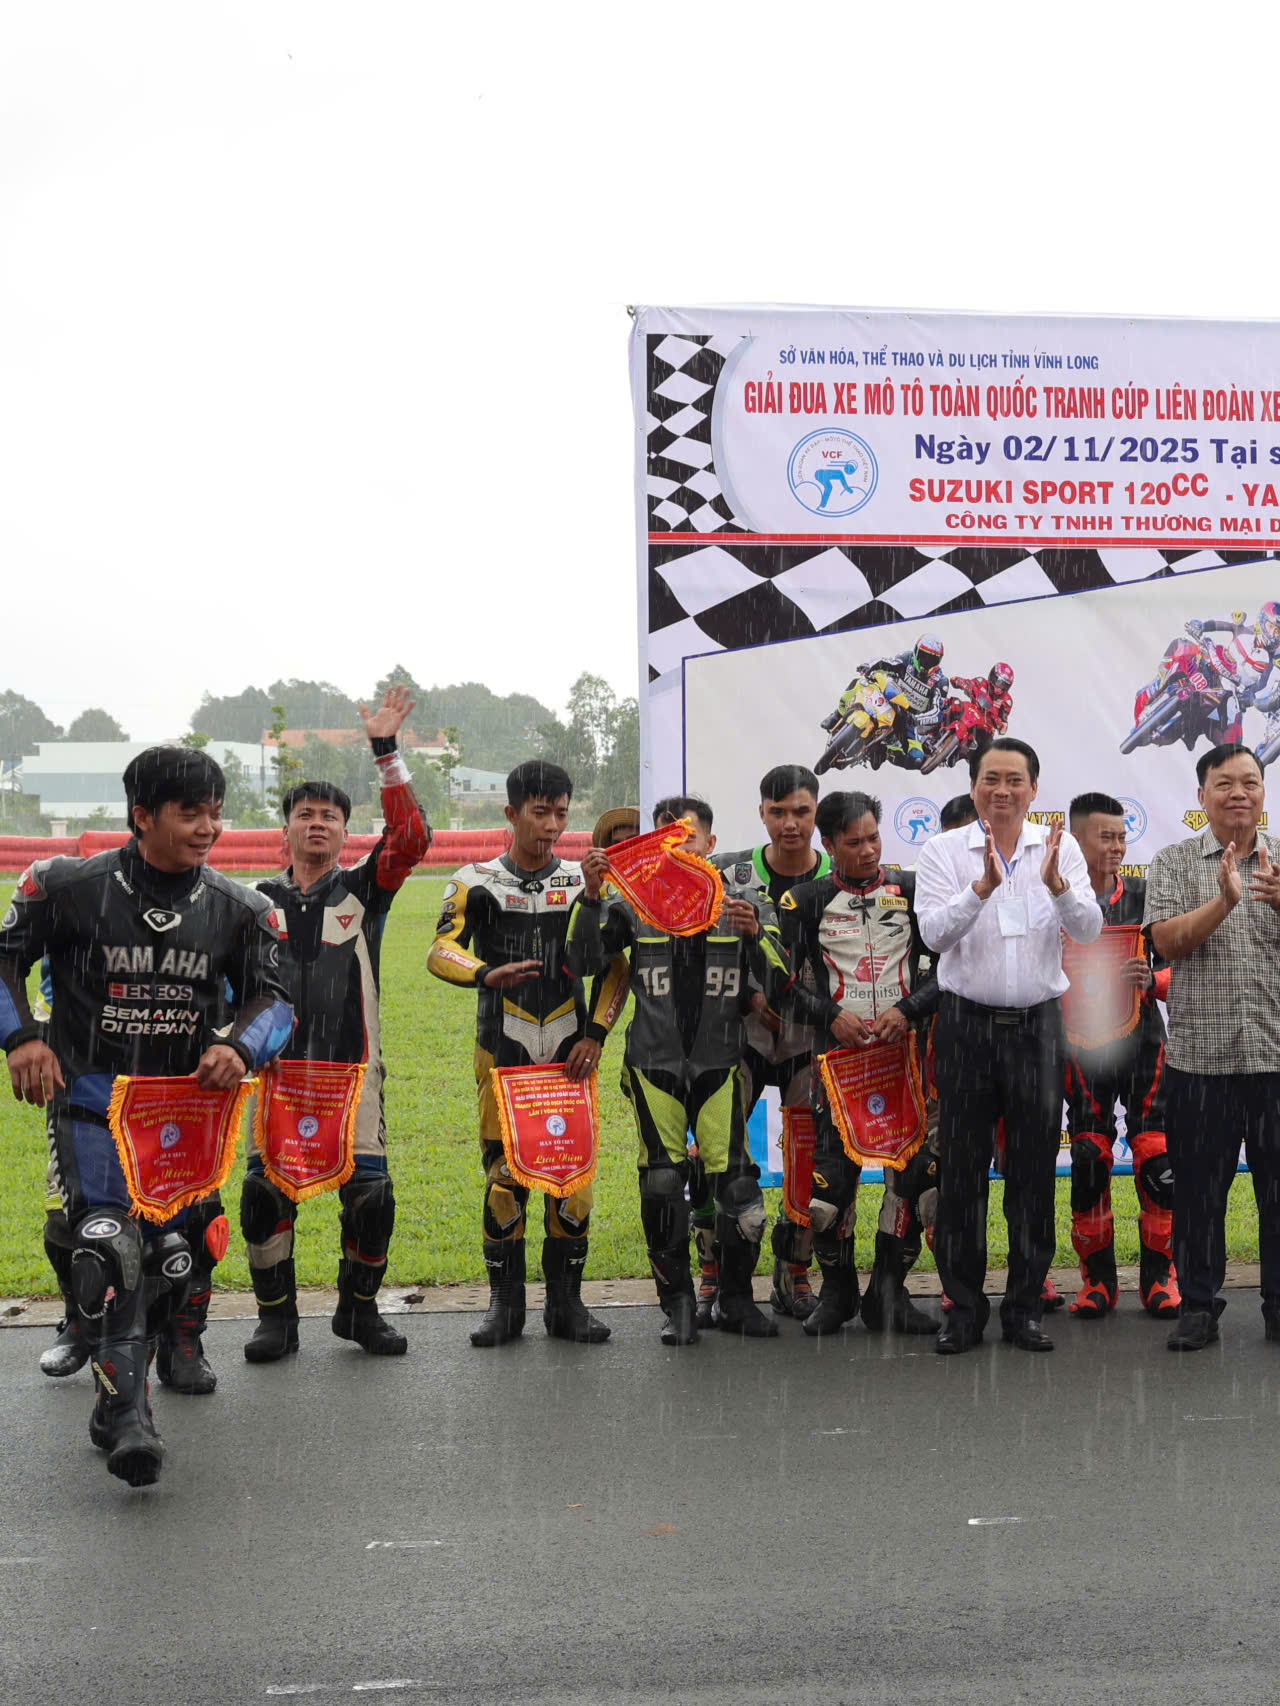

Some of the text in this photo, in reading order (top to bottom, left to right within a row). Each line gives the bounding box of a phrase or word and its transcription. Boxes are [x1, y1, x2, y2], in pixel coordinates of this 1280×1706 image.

[779, 344, 1099, 371] SỞ VĂN HÓA, THỂ THAO VÀ DU LỊCH TỈNH VĨNH LONG
[744, 370, 783, 414] GIẢI
[789, 381, 828, 414] ĐUA
[833, 383, 858, 415] XE
[864, 377, 895, 416] MÔ
[900, 378, 924, 416] TÔ
[929, 379, 981, 417] TOÀN
[986, 374, 1038, 421] QUỐC
[1043, 386, 1105, 419] TRANH
[1111, 381, 1150, 420] CÚP
[1155, 382, 1198, 421] LIÊN
[1202, 383, 1255, 422] ĐOÀN
[822, 450, 843, 459] VCF
[915, 434, 991, 465] Ngày
[1210, 438, 1258, 469] Tại
[909, 478, 1013, 504] SUZUKI
[1022, 479, 1114, 505] SPORT
[945, 511, 1008, 530] CÔNG
[1015, 514, 1043, 530] TY
[1051, 515, 1113, 531] TNHH
[1121, 514, 1212, 532] THƯƠNG
[1220, 517, 1262, 535] MẠI
[551, 876, 568, 887] elf
[126, 985, 192, 999] ENEOS
[706, 966, 741, 997] 99
[845, 985, 900, 1000] idemitsu
